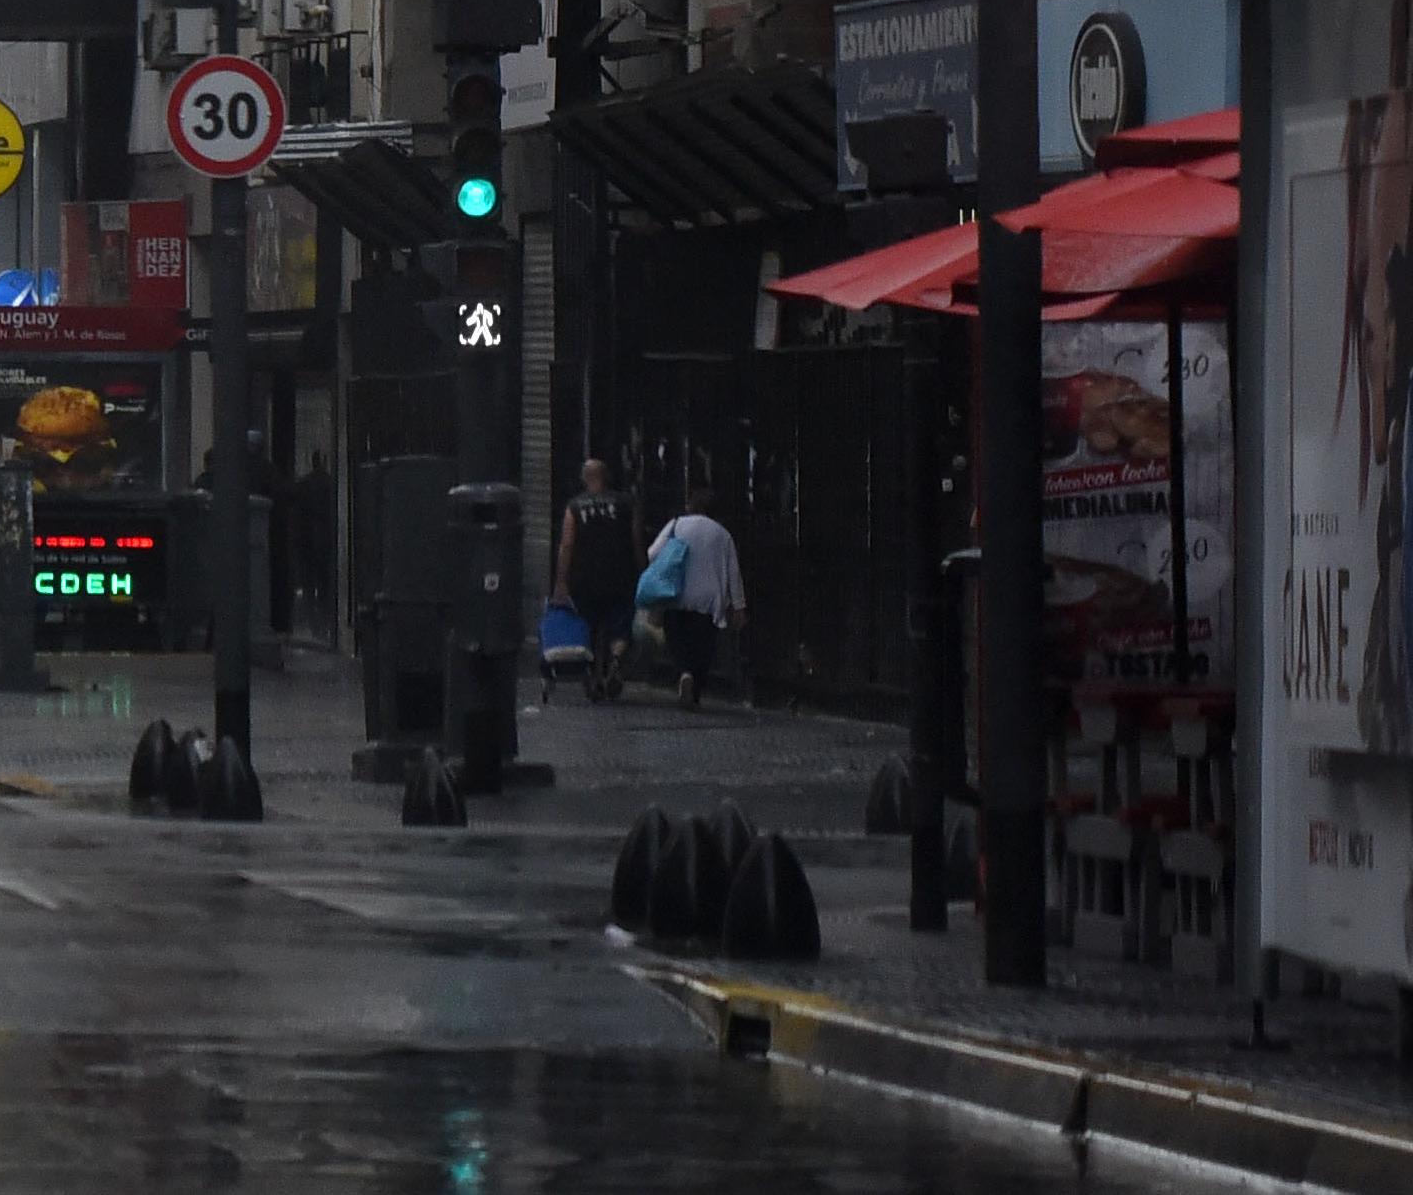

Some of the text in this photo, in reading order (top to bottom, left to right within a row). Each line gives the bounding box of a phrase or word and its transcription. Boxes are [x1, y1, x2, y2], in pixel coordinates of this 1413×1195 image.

[838, 3, 979, 61] ESTACIONAMIENT
[192, 92, 258, 142] 30
[1041, 490, 1171, 521] MEDIALUNA
